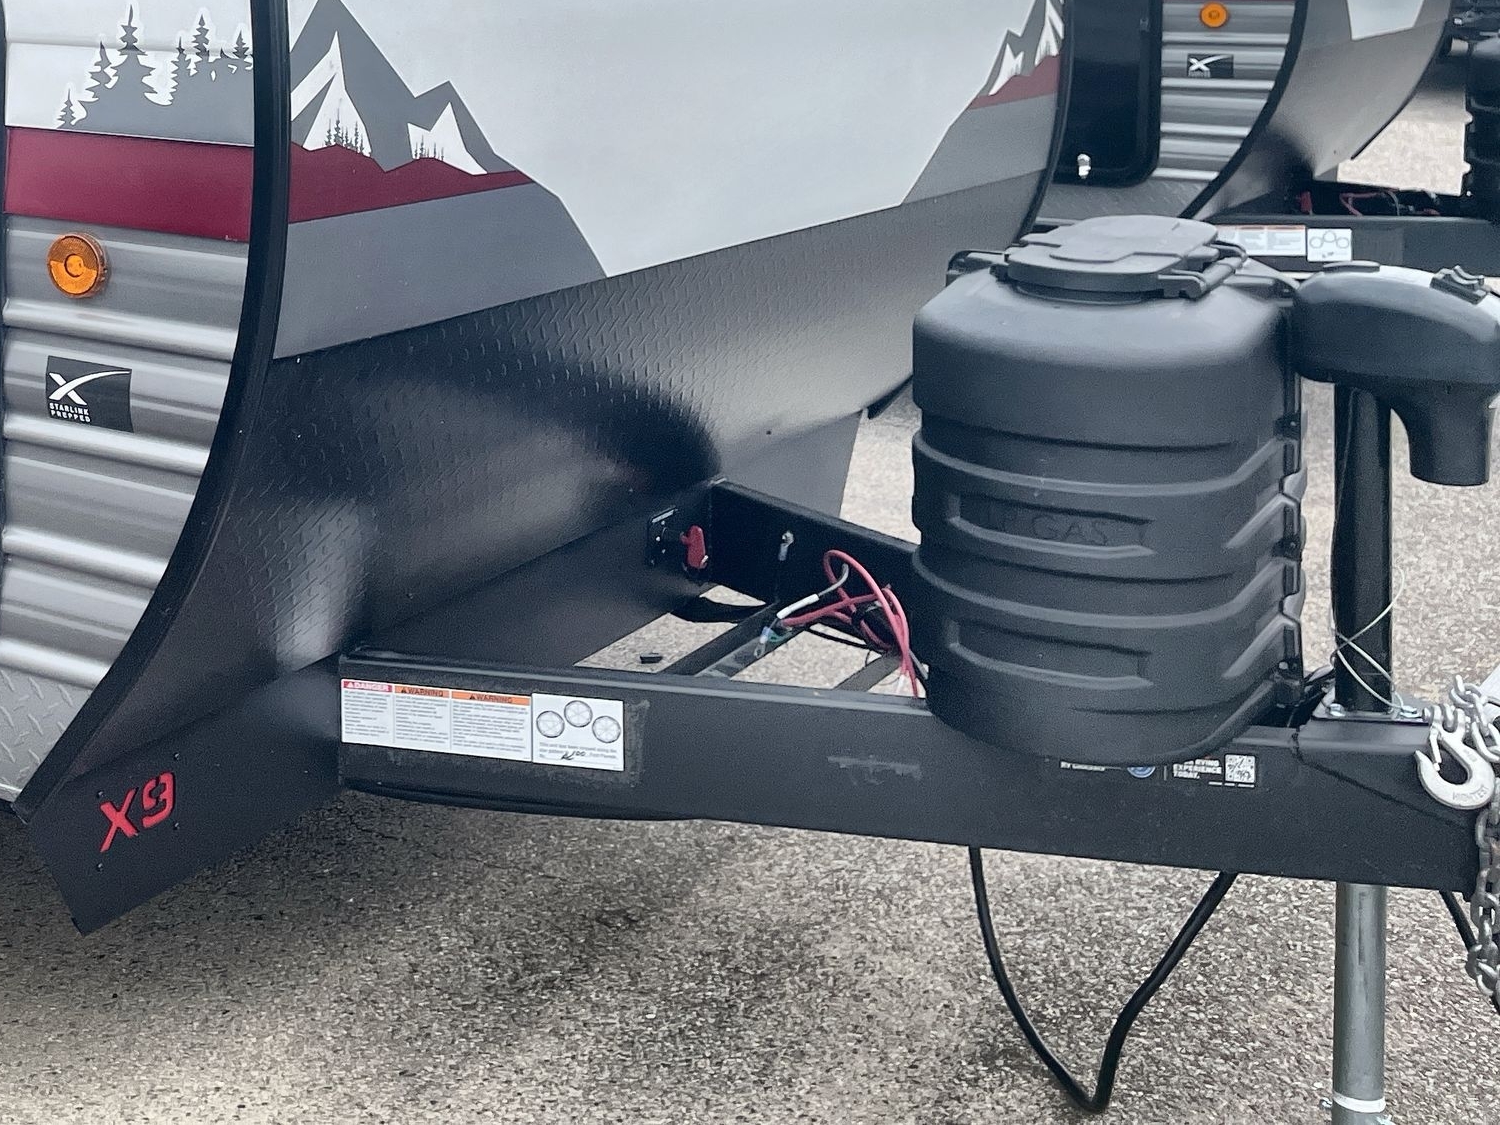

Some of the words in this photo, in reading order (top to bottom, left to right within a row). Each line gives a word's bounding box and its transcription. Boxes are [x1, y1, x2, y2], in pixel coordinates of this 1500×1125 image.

[49, 402, 89, 415] STARLINK
[50, 409, 91, 423] PREPPED
[353, 682, 389, 692] DANGER
[408, 688, 444, 697] WARNING
[477, 693, 513, 704] WARNING
